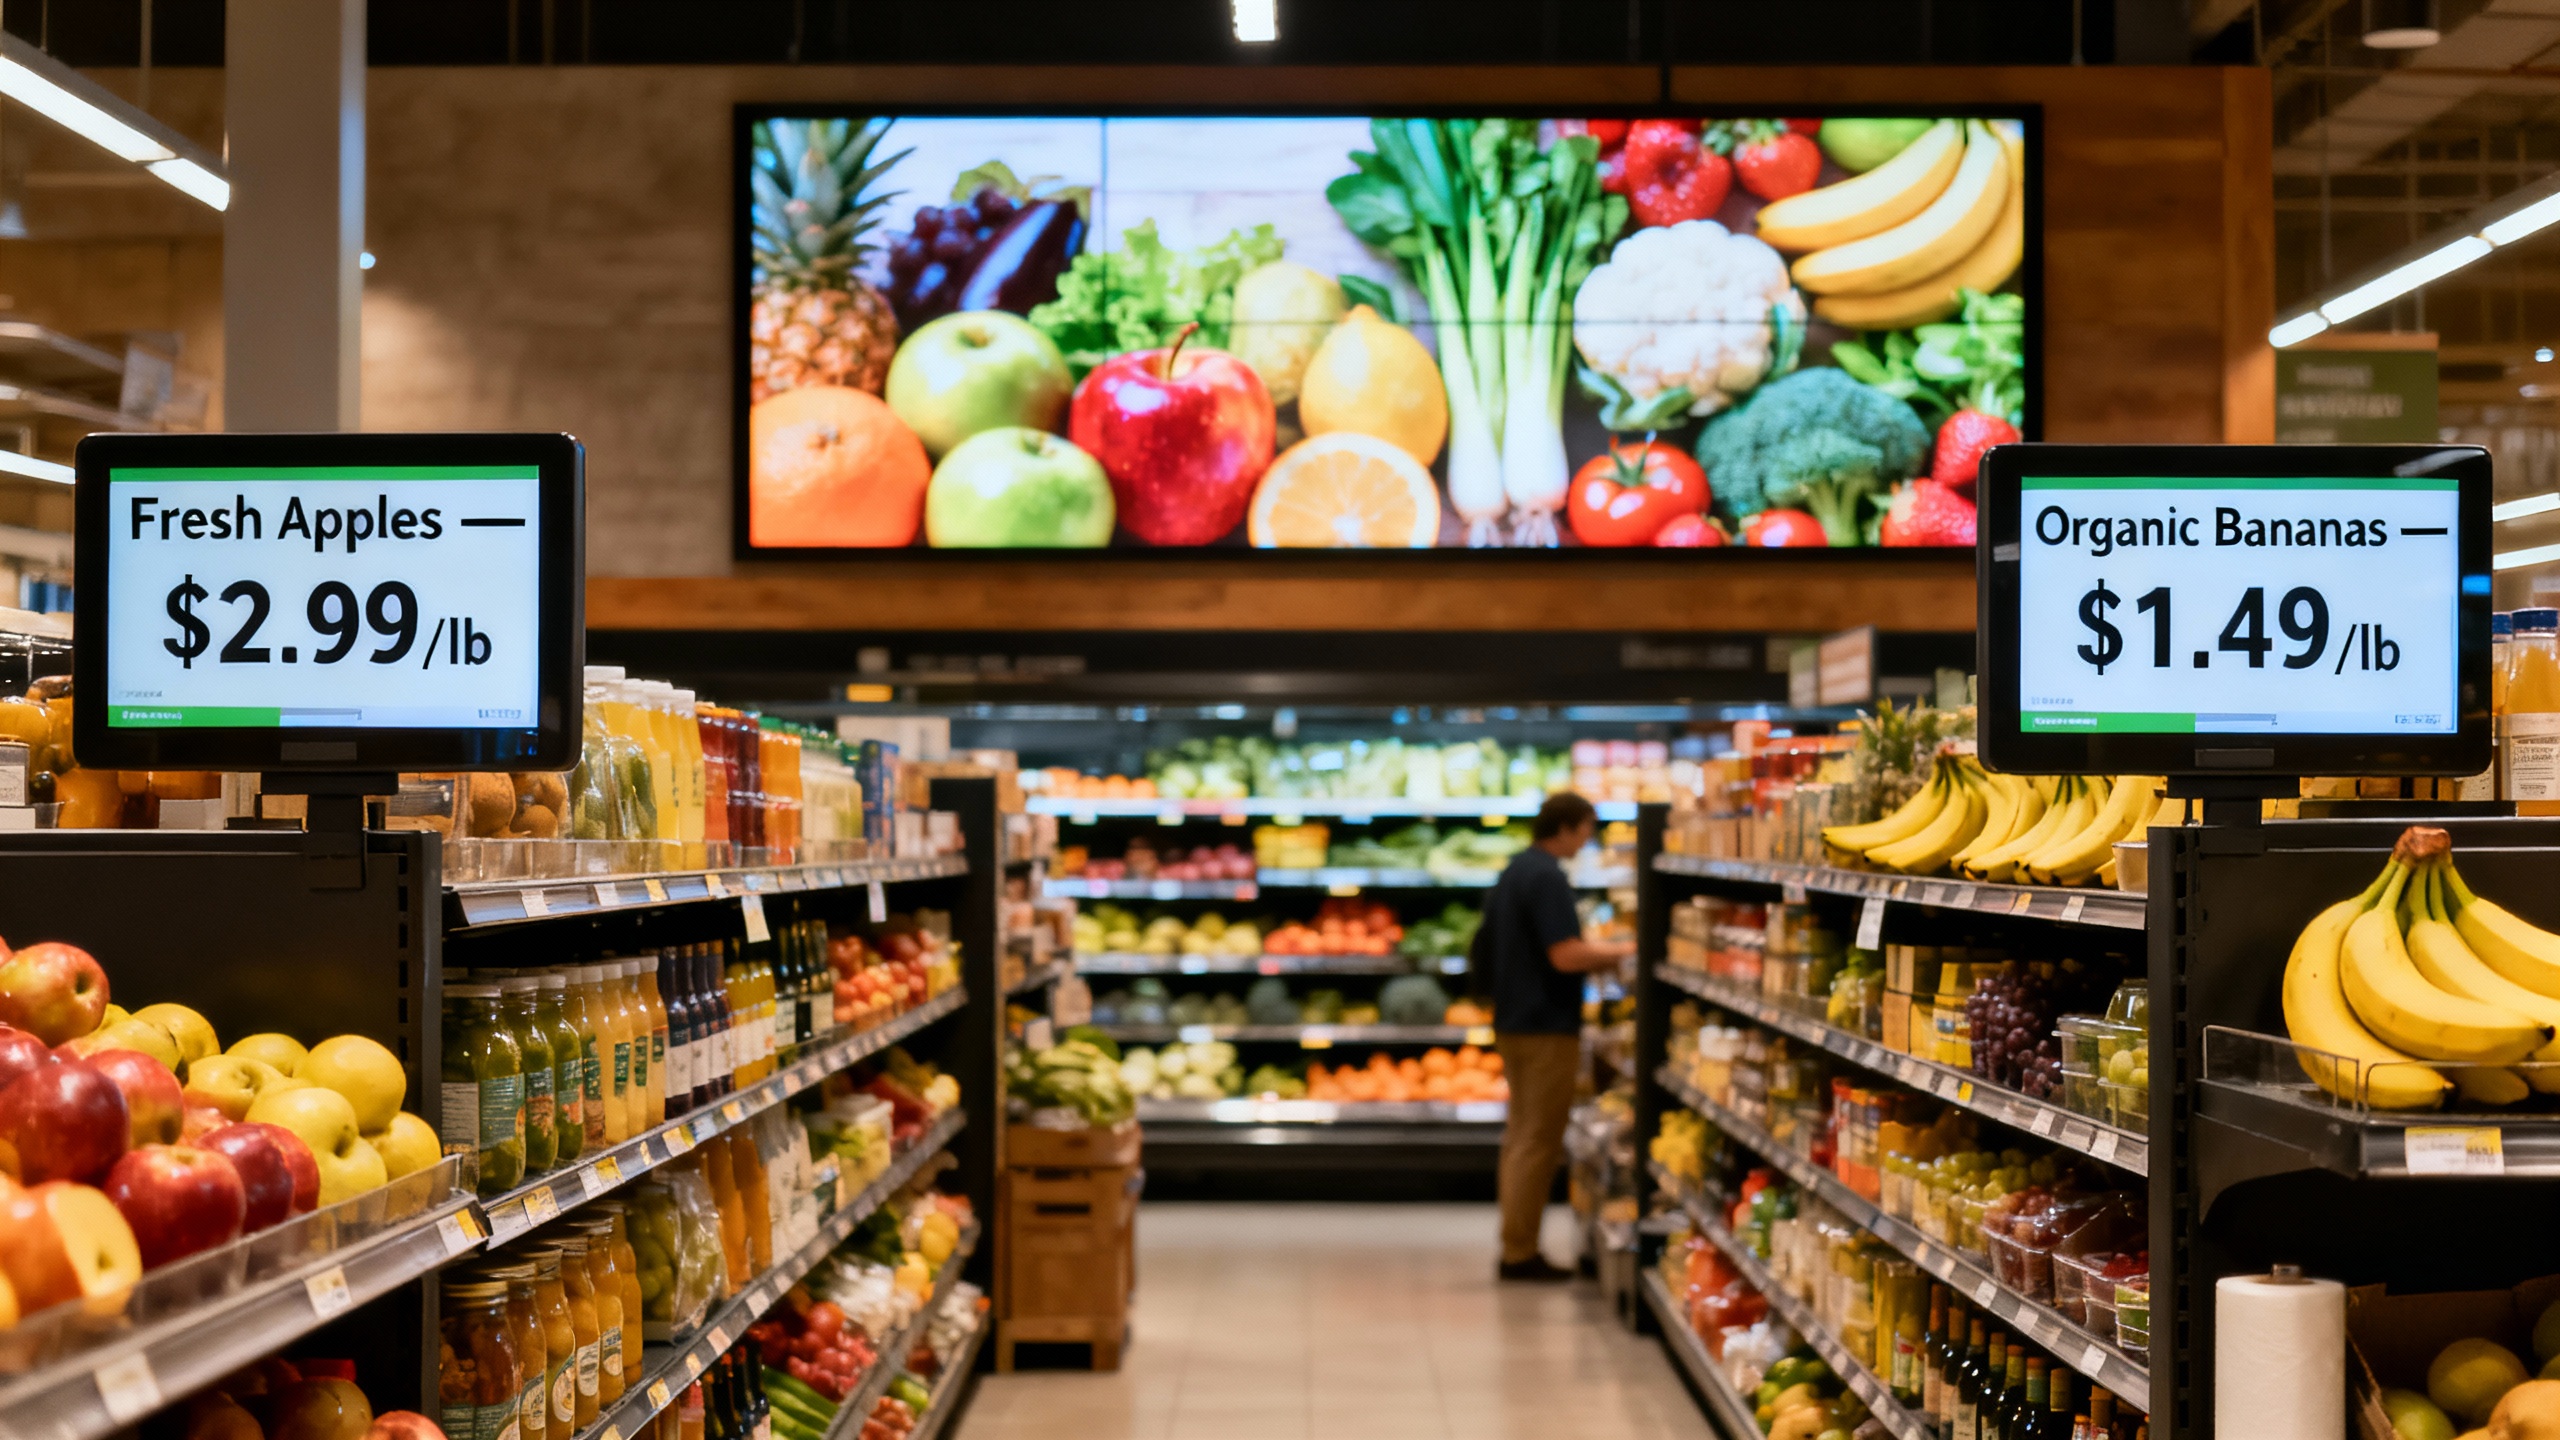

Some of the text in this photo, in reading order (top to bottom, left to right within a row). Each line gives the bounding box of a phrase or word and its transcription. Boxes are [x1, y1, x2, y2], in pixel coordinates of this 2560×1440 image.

[131, 493, 262, 540] Fresh
[277, 493, 443, 554] Apples
[2035, 505, 2200, 558] Organic
[2215, 505, 2388, 547] Bananas
